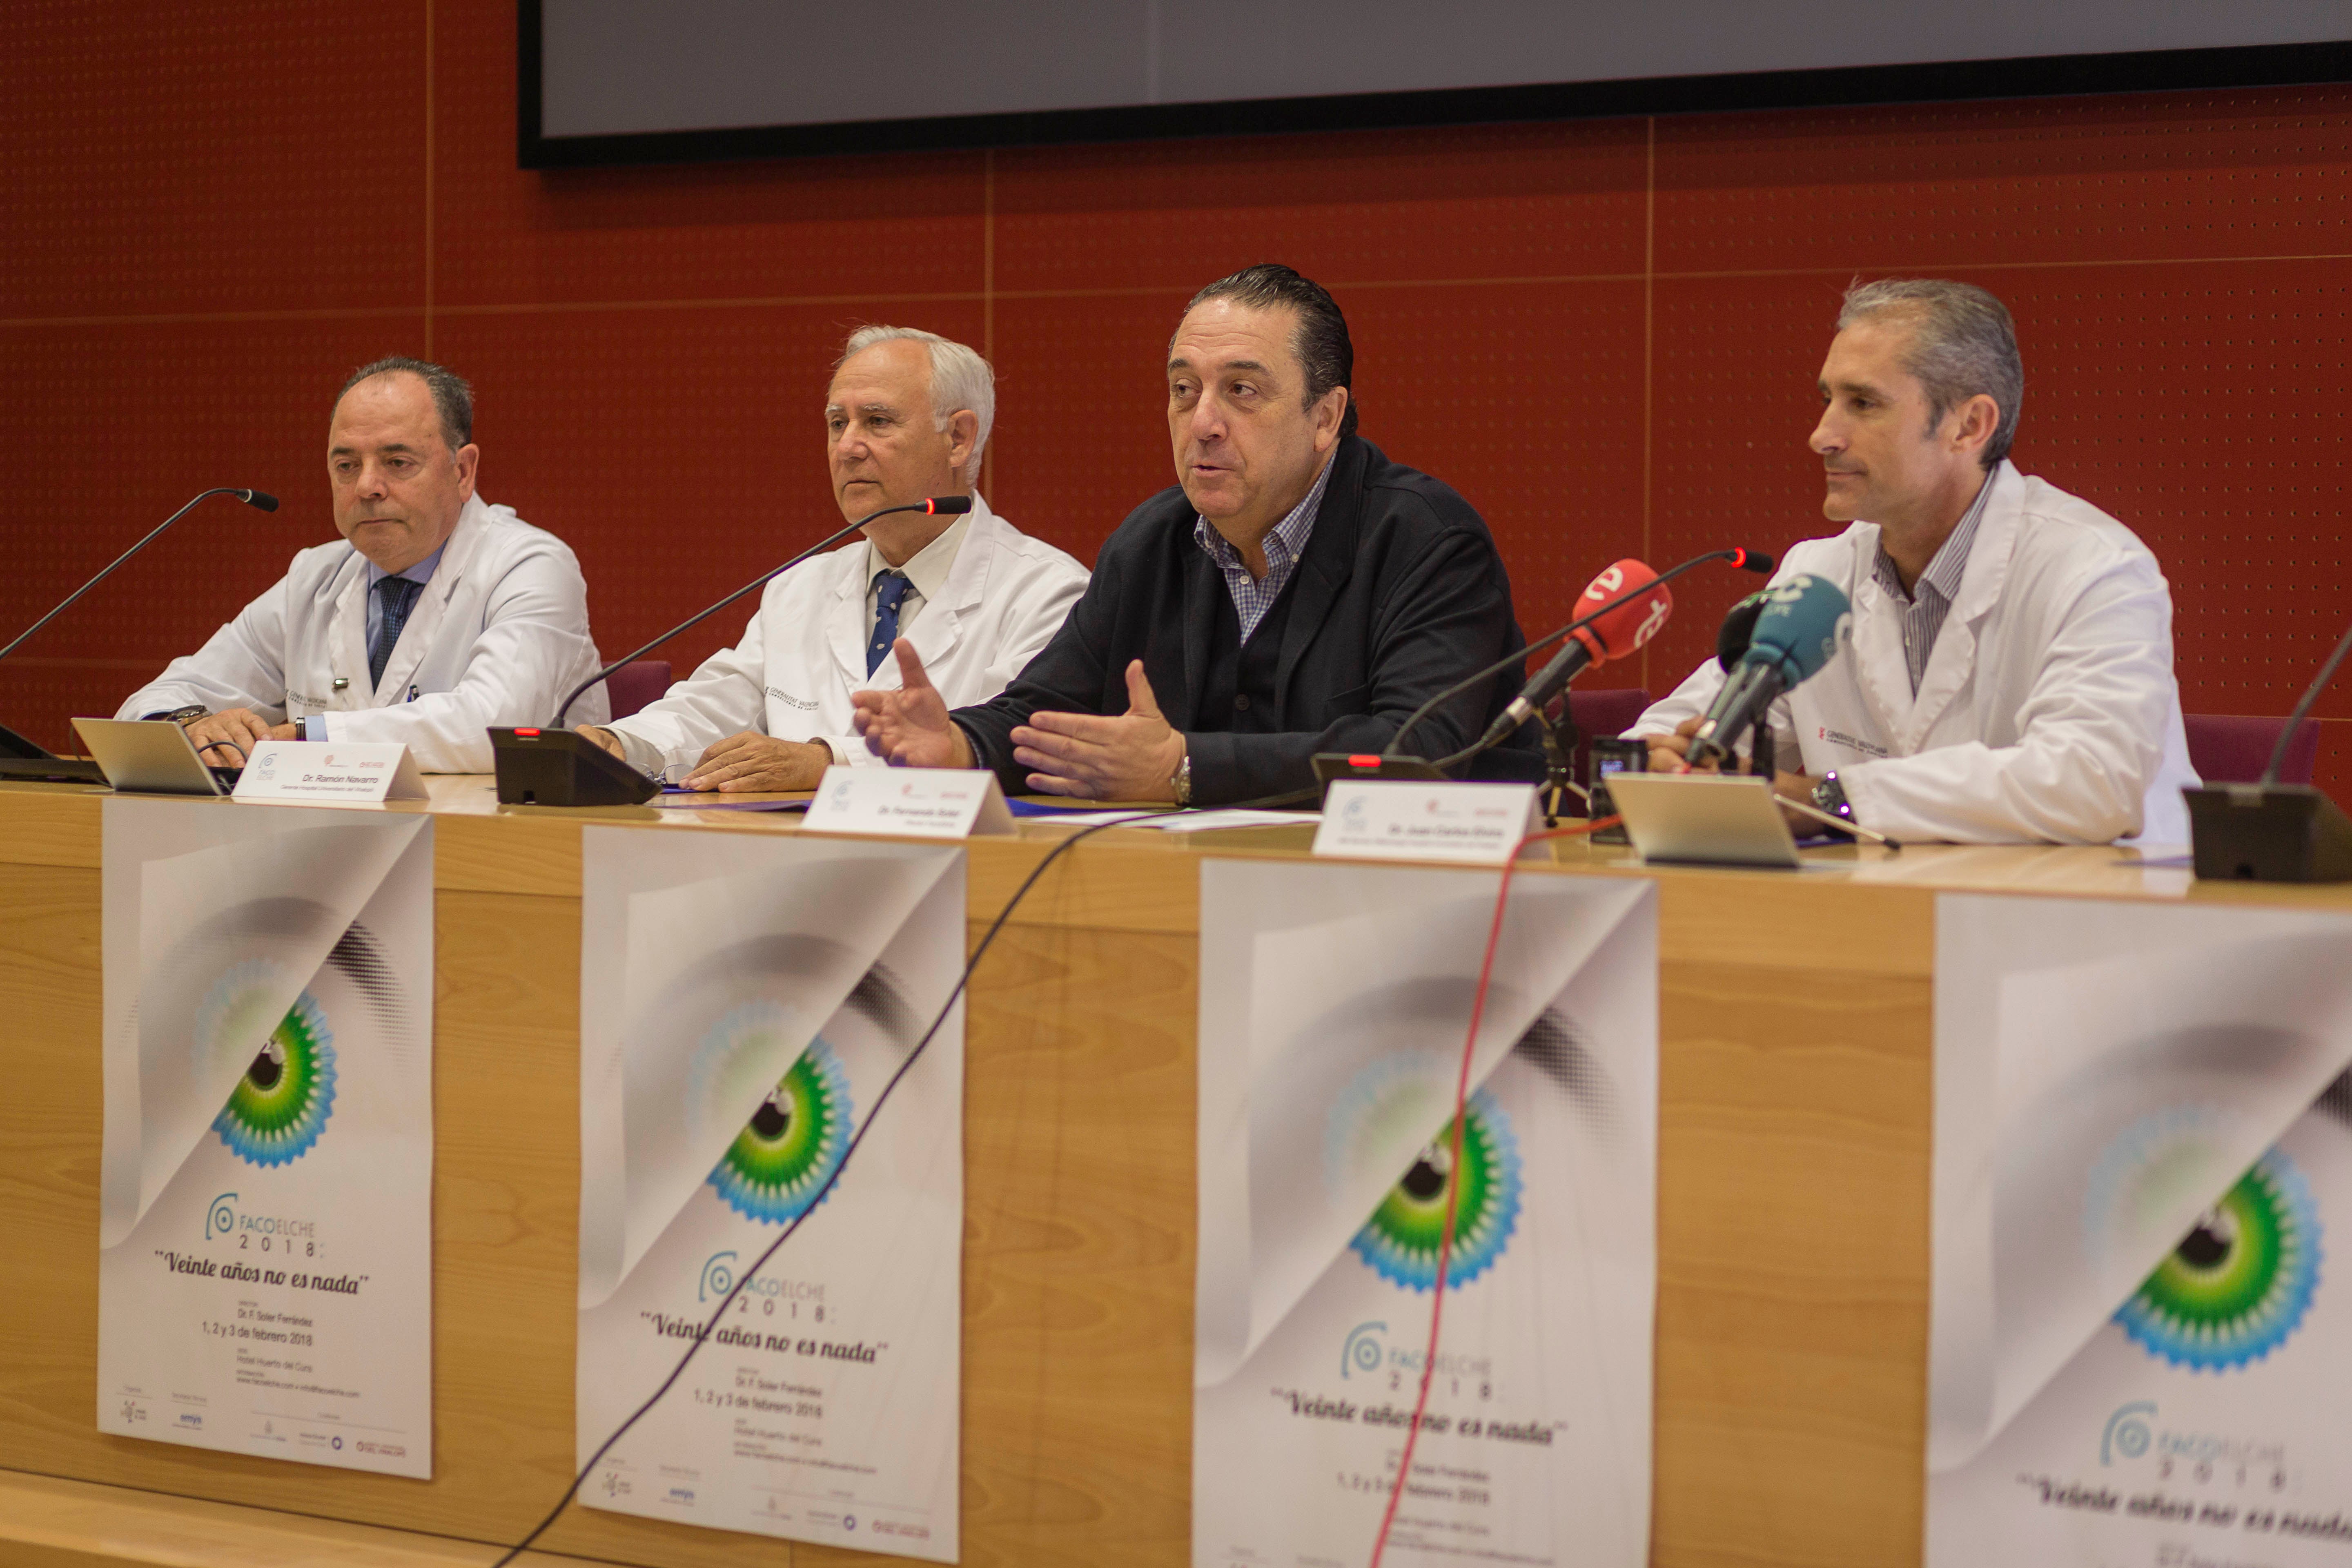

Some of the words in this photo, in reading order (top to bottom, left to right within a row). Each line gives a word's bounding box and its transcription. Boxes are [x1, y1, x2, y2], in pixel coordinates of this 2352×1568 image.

[316, 774, 344, 783] Ramón
[239, 1215, 314, 1238] FACOELCHE
[221, 1262, 260, 1283] años
[264, 1270, 286, 1286] no
[291, 1274, 308, 1289] es
[740, 1275, 826, 1301] ACOELCHE
[256, 1310, 275, 1322] Soler
[212, 1323, 218, 1335] 2
[220, 1326, 227, 1337] y
[229, 1325, 235, 1336] 3
[237, 1327, 250, 1339] de
[252, 1327, 287, 1343] febrero
[290, 1332, 312, 1347] 2018
[716, 1325, 761, 1350] años
[766, 1332, 791, 1352] no
[797, 1340, 816, 1356] es
